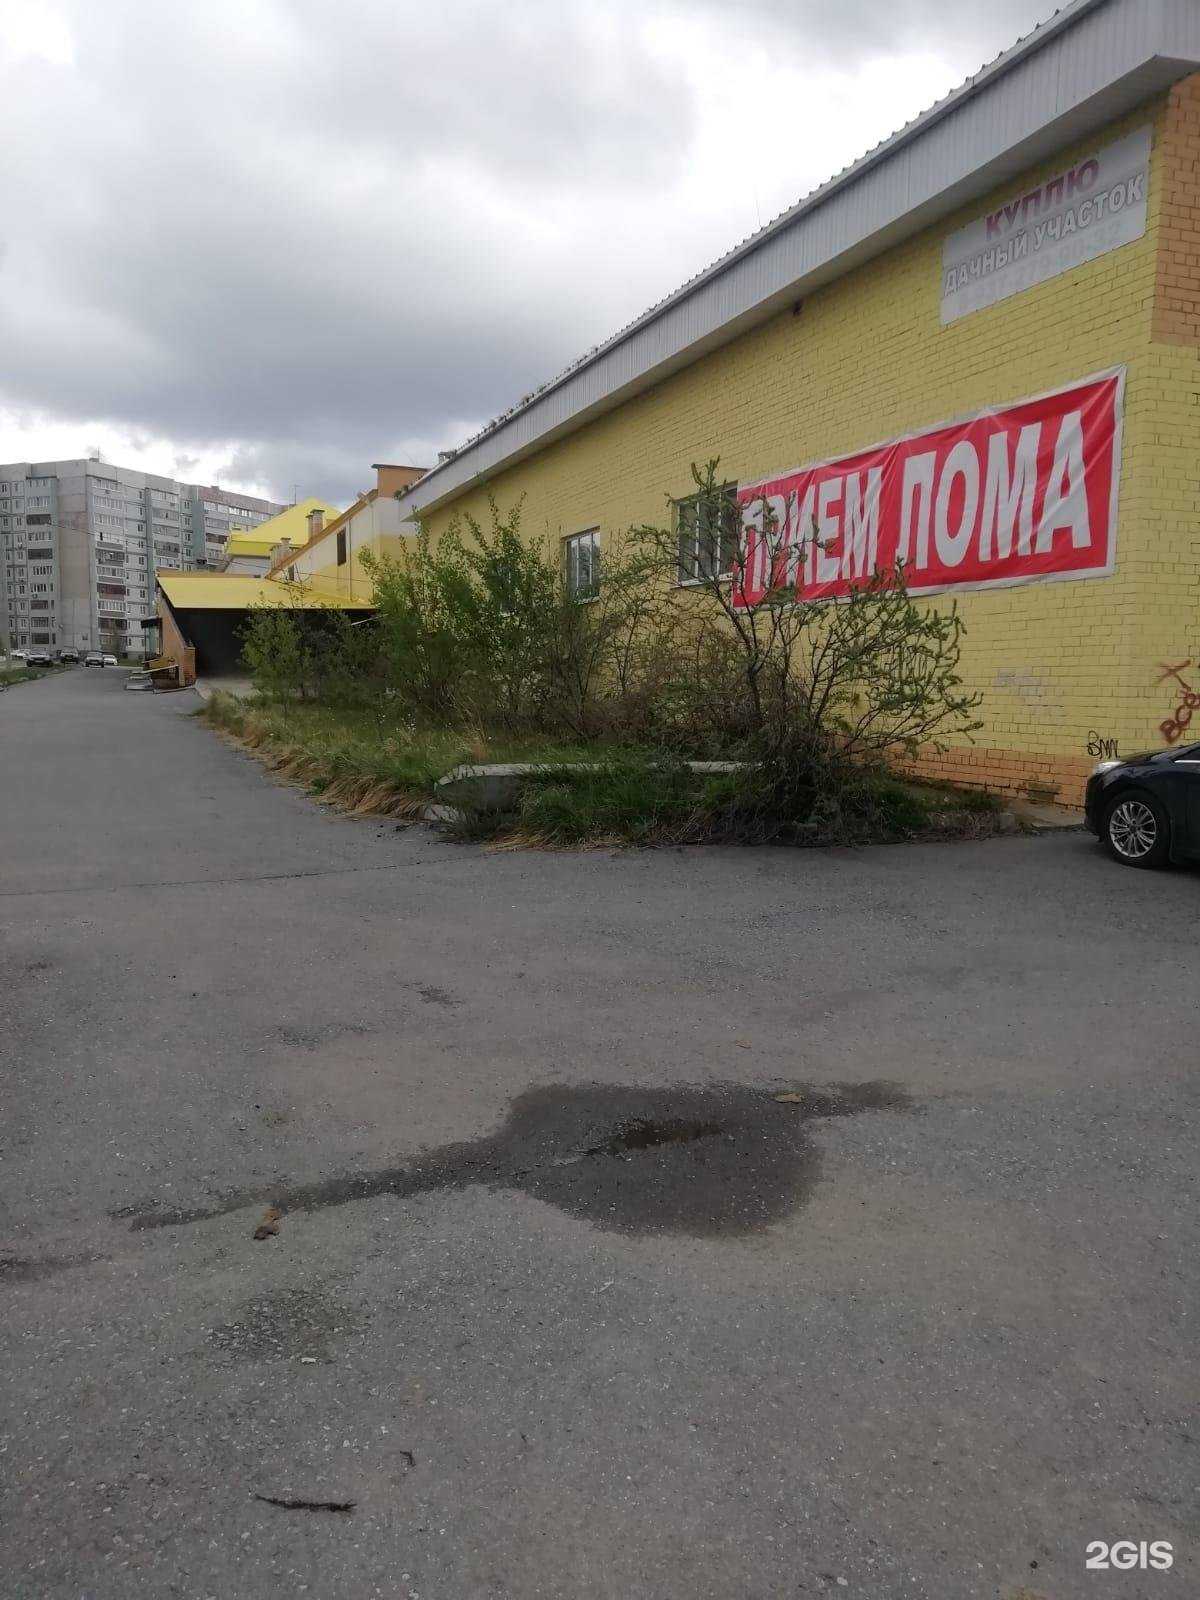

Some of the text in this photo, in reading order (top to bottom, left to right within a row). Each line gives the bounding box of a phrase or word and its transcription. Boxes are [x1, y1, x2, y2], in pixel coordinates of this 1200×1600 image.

[943, 172, 1145, 297] ДАЧНЫЙ УЧАСТОК
[984, 158, 1099, 239] КУПЛЮ
[737, 410, 1092, 595] ПРИЕМ ЛОМА
